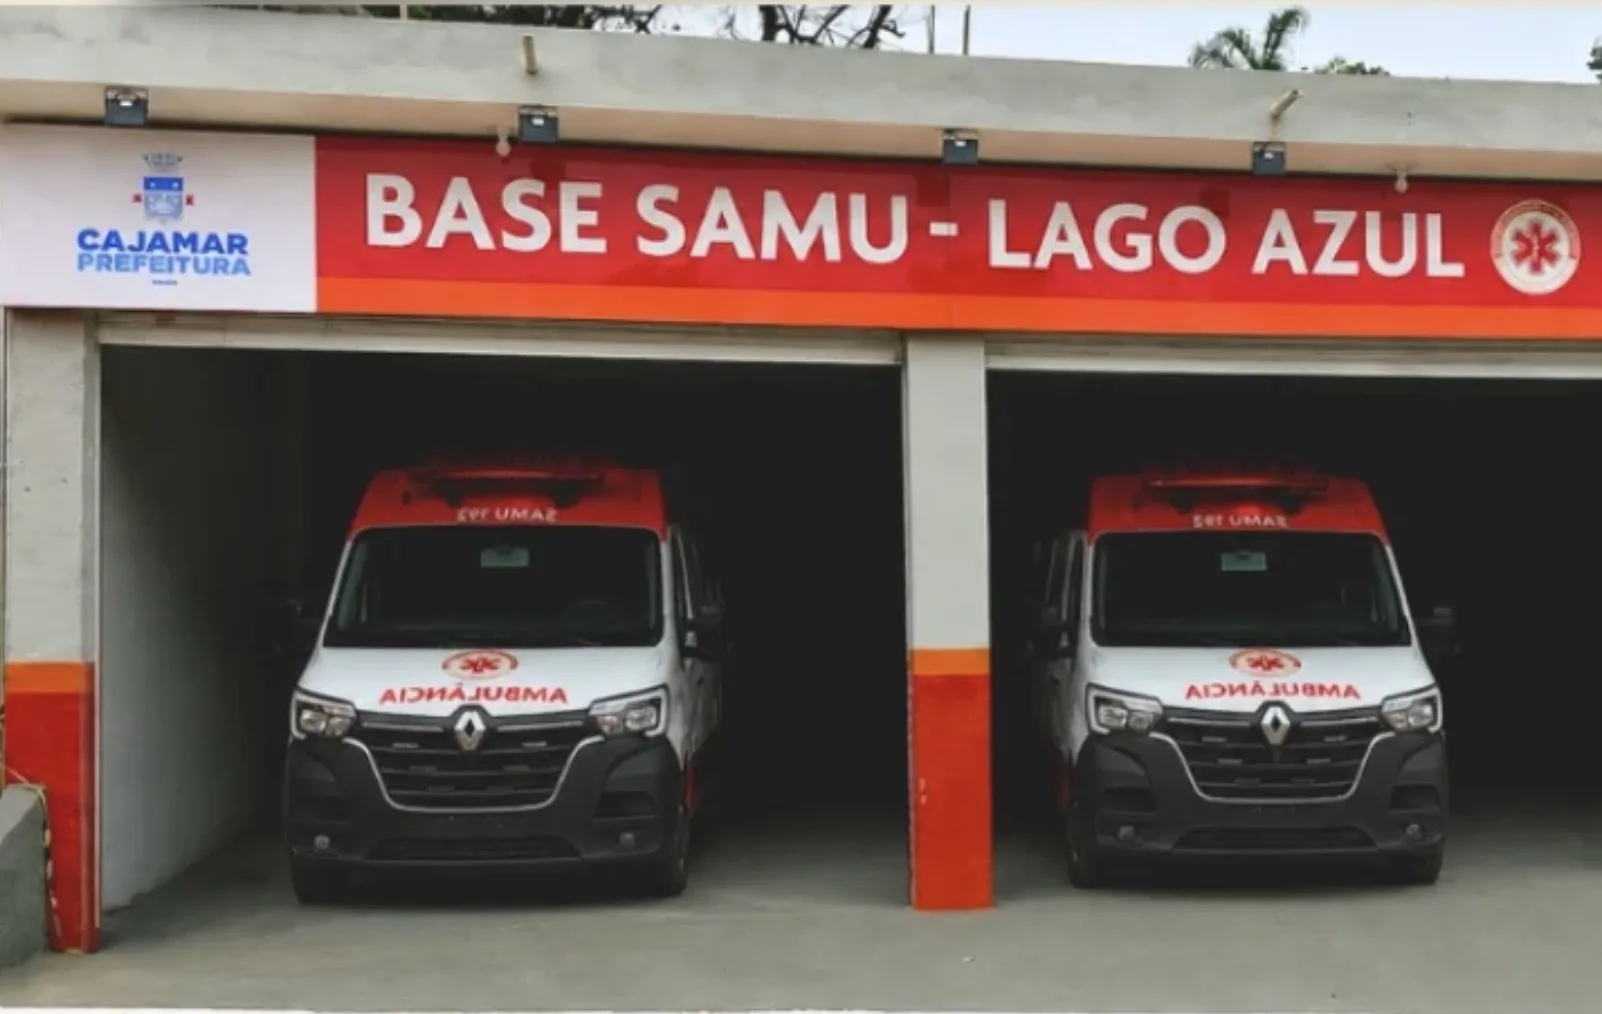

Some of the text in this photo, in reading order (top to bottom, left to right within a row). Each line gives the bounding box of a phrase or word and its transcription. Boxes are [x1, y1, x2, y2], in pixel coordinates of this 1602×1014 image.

[366, 174, 608, 255] BASE
[636, 184, 909, 265] SAMU
[930, 222, 958, 238] -
[989, 200, 1227, 274] LAGO
[1252, 209, 1466, 278] AZUL
[77, 228, 249, 255] CAJAMAR
[77, 253, 251, 277] PREFEITURA
